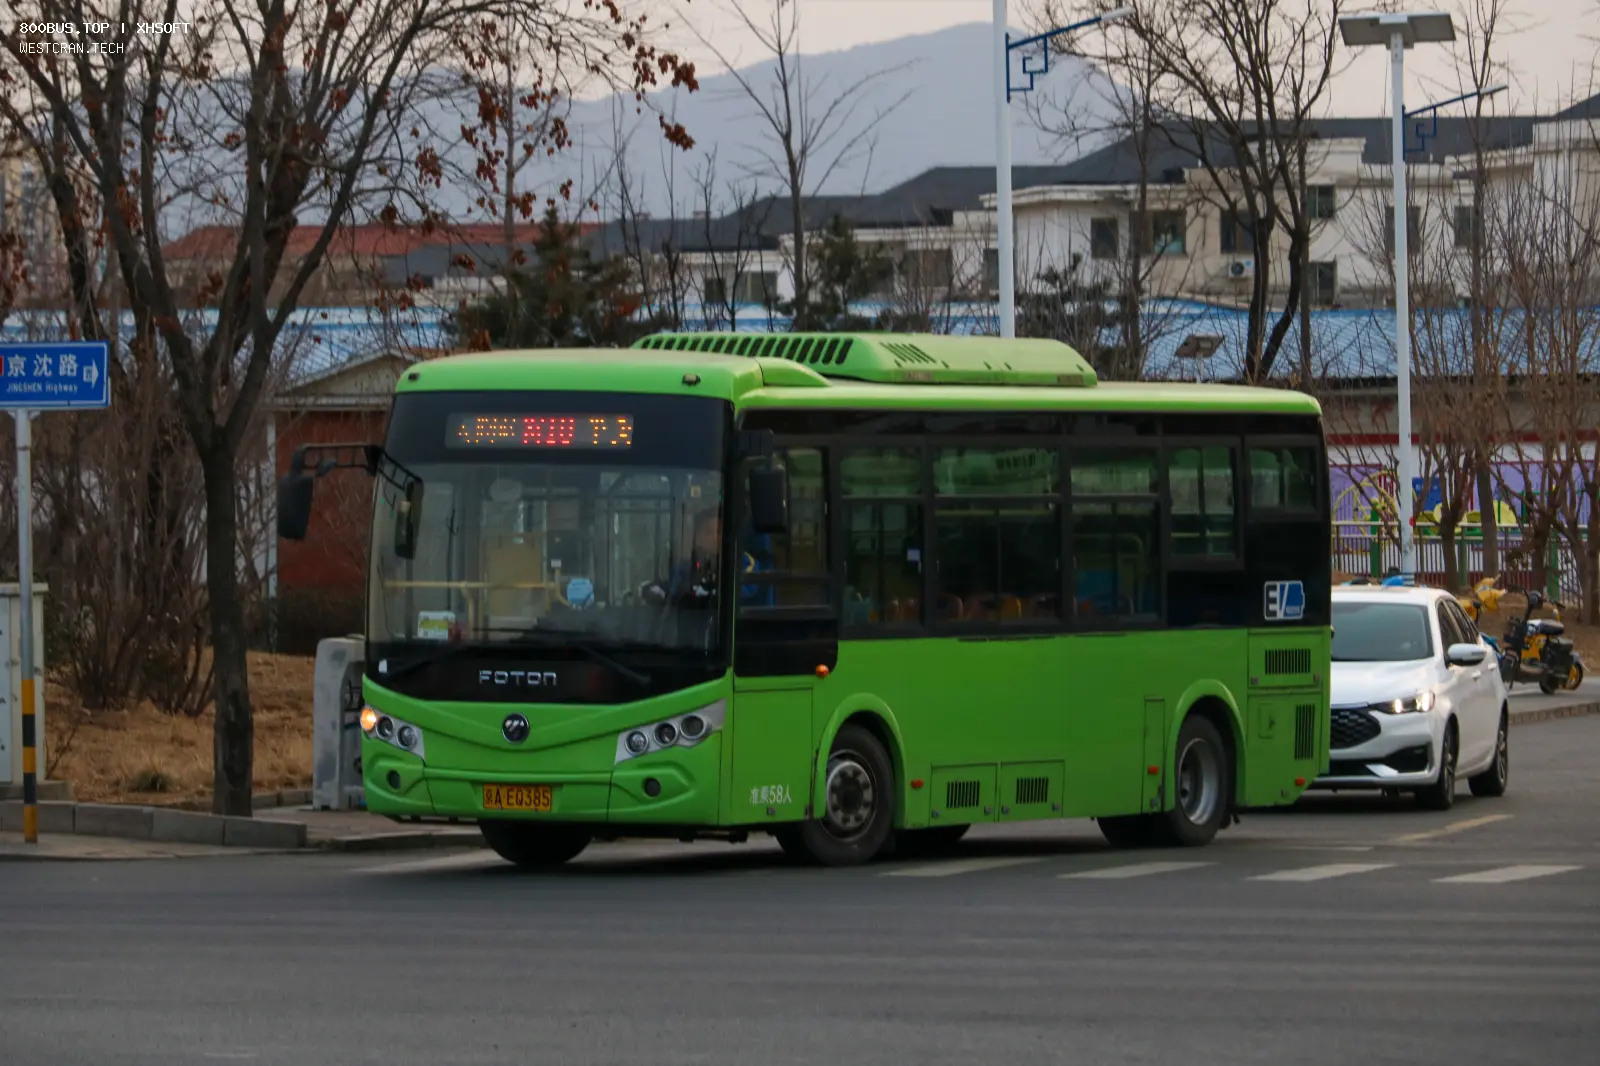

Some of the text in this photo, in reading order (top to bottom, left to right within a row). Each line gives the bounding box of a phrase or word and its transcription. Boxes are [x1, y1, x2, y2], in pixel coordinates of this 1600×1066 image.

[7, 353, 79, 377] 京沈路
[6, 381, 79, 395] JINGSHEN Highway
[479, 669, 557, 686] FOTON
